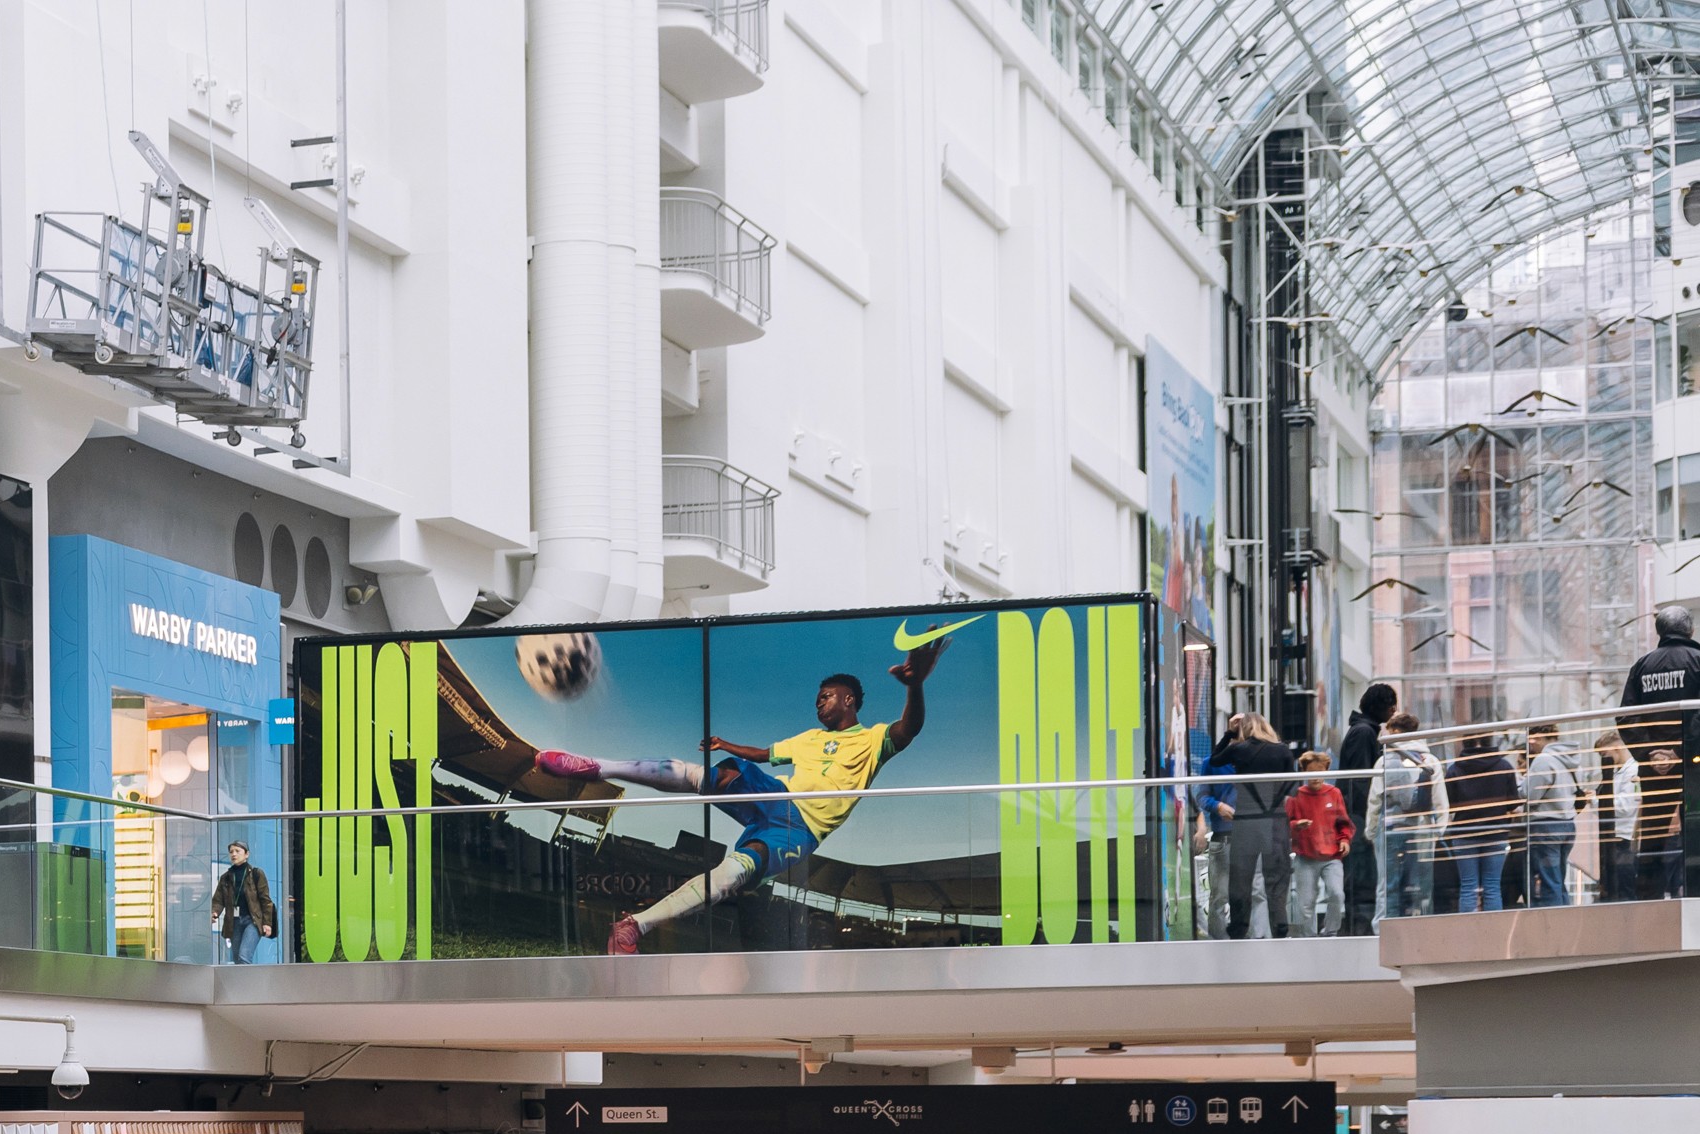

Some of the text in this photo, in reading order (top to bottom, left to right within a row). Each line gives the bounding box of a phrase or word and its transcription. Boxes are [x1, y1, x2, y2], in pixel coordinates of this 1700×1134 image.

[128, 603, 257, 665] WARBY PARKER
[1641, 669, 1686, 693] SECURITY
[998, 603, 1141, 945] DO IT
[304, 641, 438, 962] JUST
[606, 1109, 660, 1121] Queen St.
[833, 1106, 923, 1114] QUEEN'S CROSS
